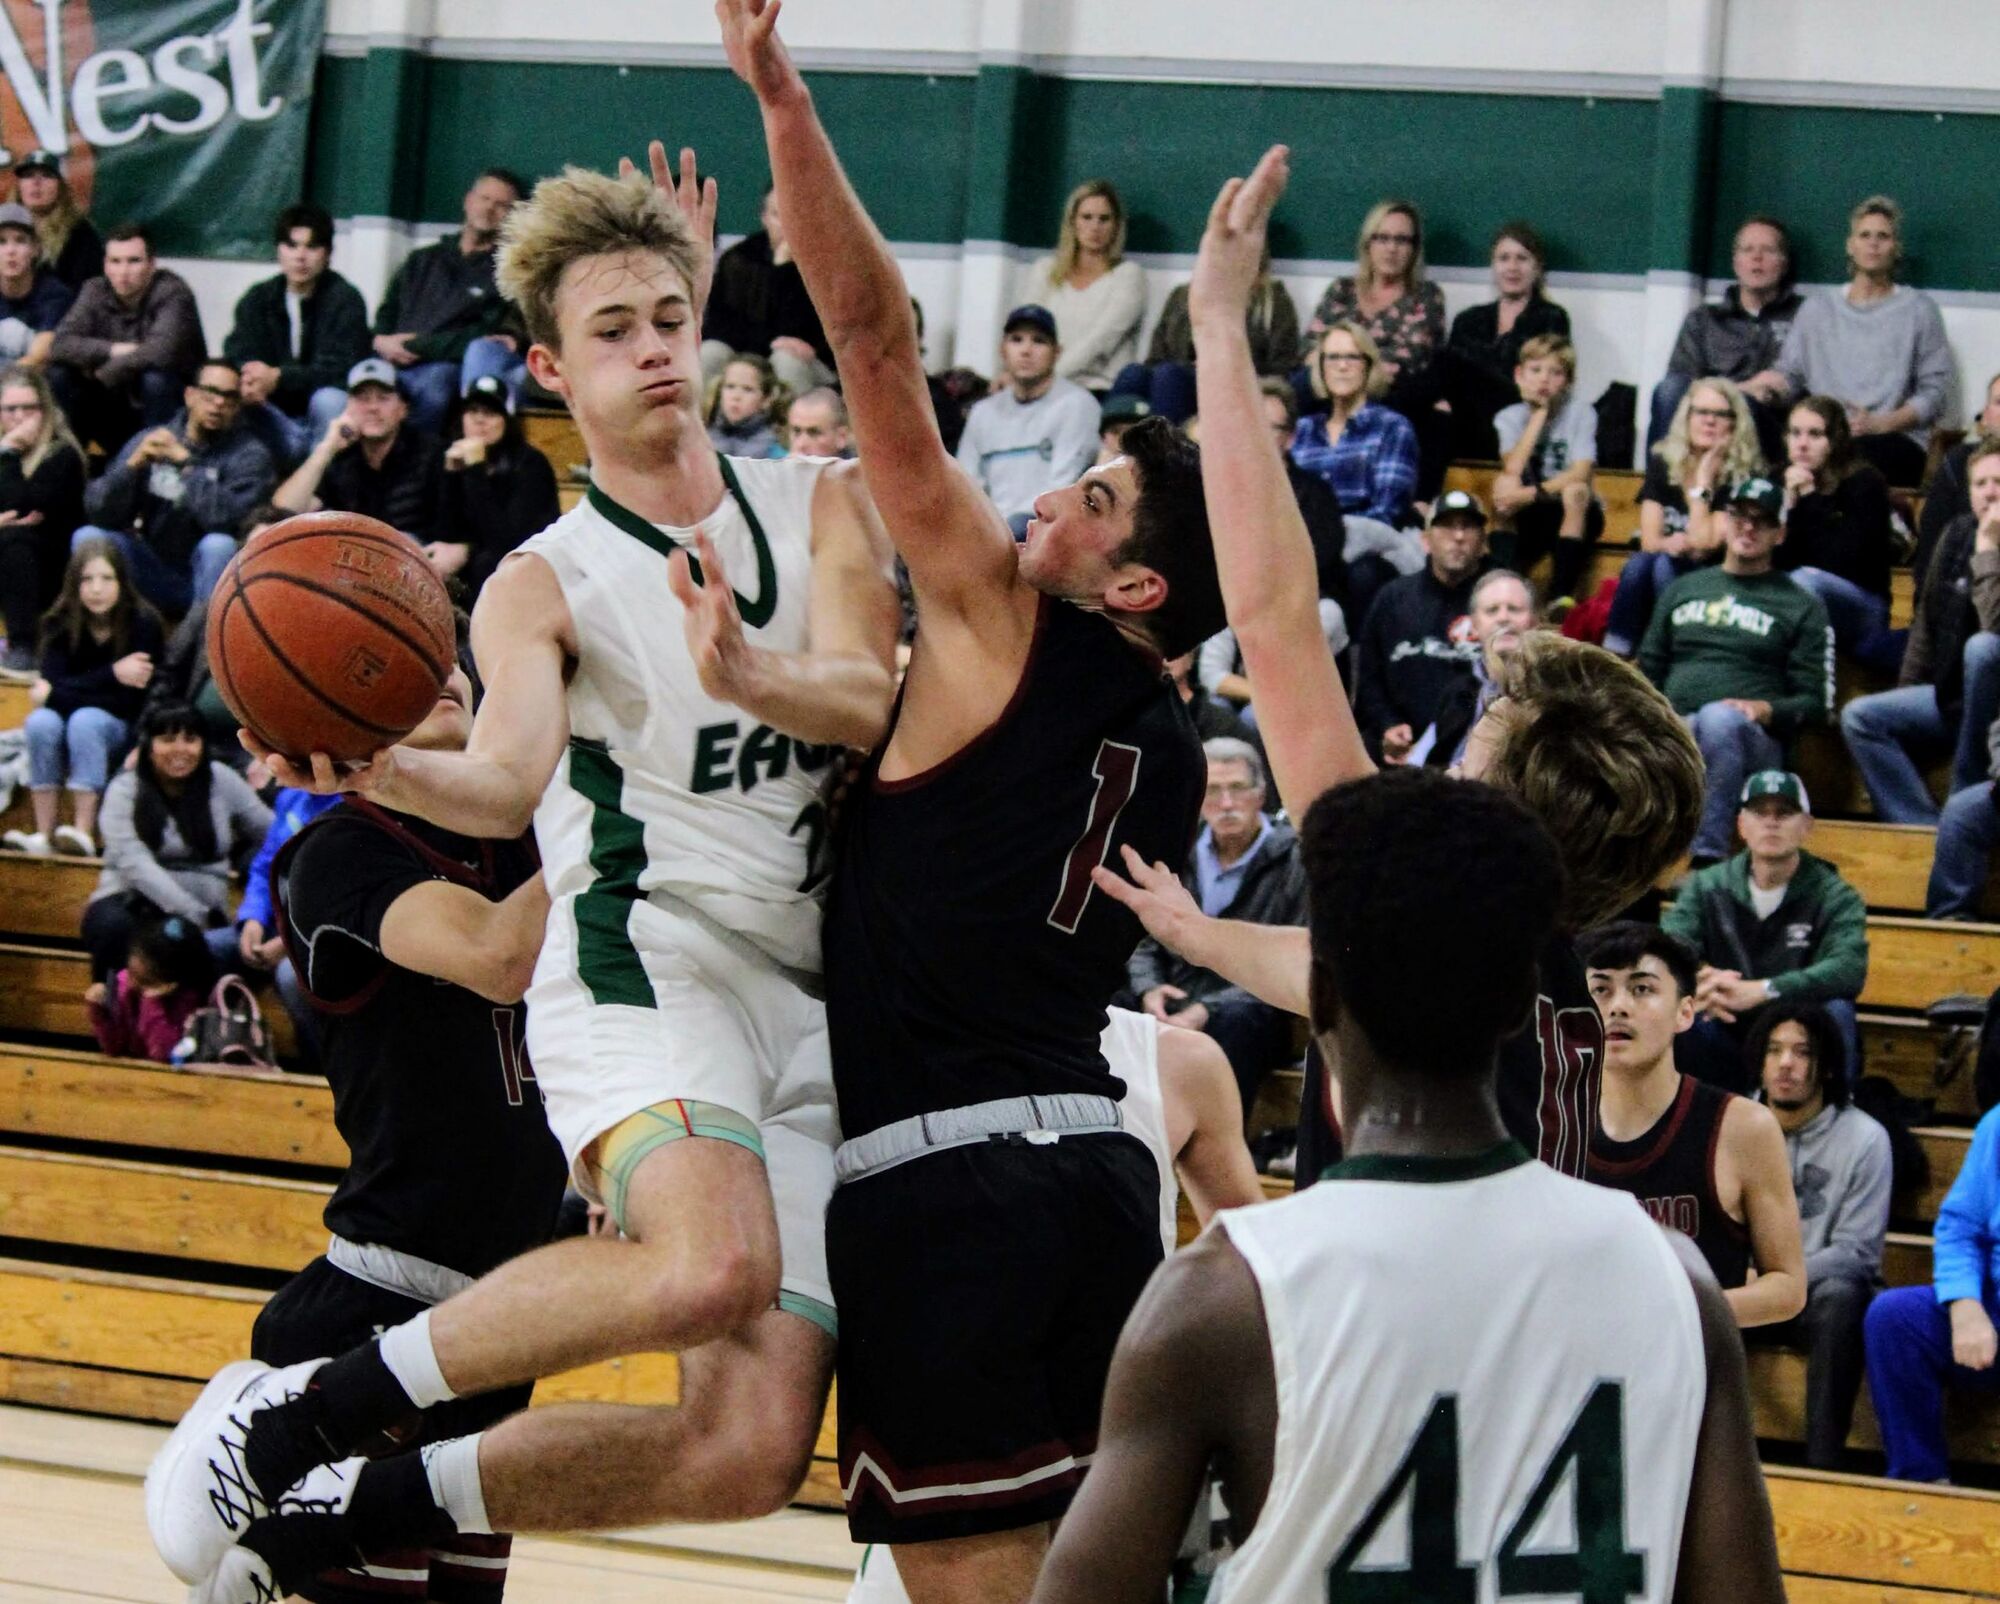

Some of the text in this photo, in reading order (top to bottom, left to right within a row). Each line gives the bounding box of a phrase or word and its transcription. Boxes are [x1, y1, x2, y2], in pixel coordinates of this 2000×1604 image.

[0, 0, 283, 154] Nest
[1672, 601, 1775, 637] CAL POLY
[1046, 738, 1141, 934] 1
[1637, 1194, 1699, 1238] MO
[1323, 1376, 1648, 1604] 44
